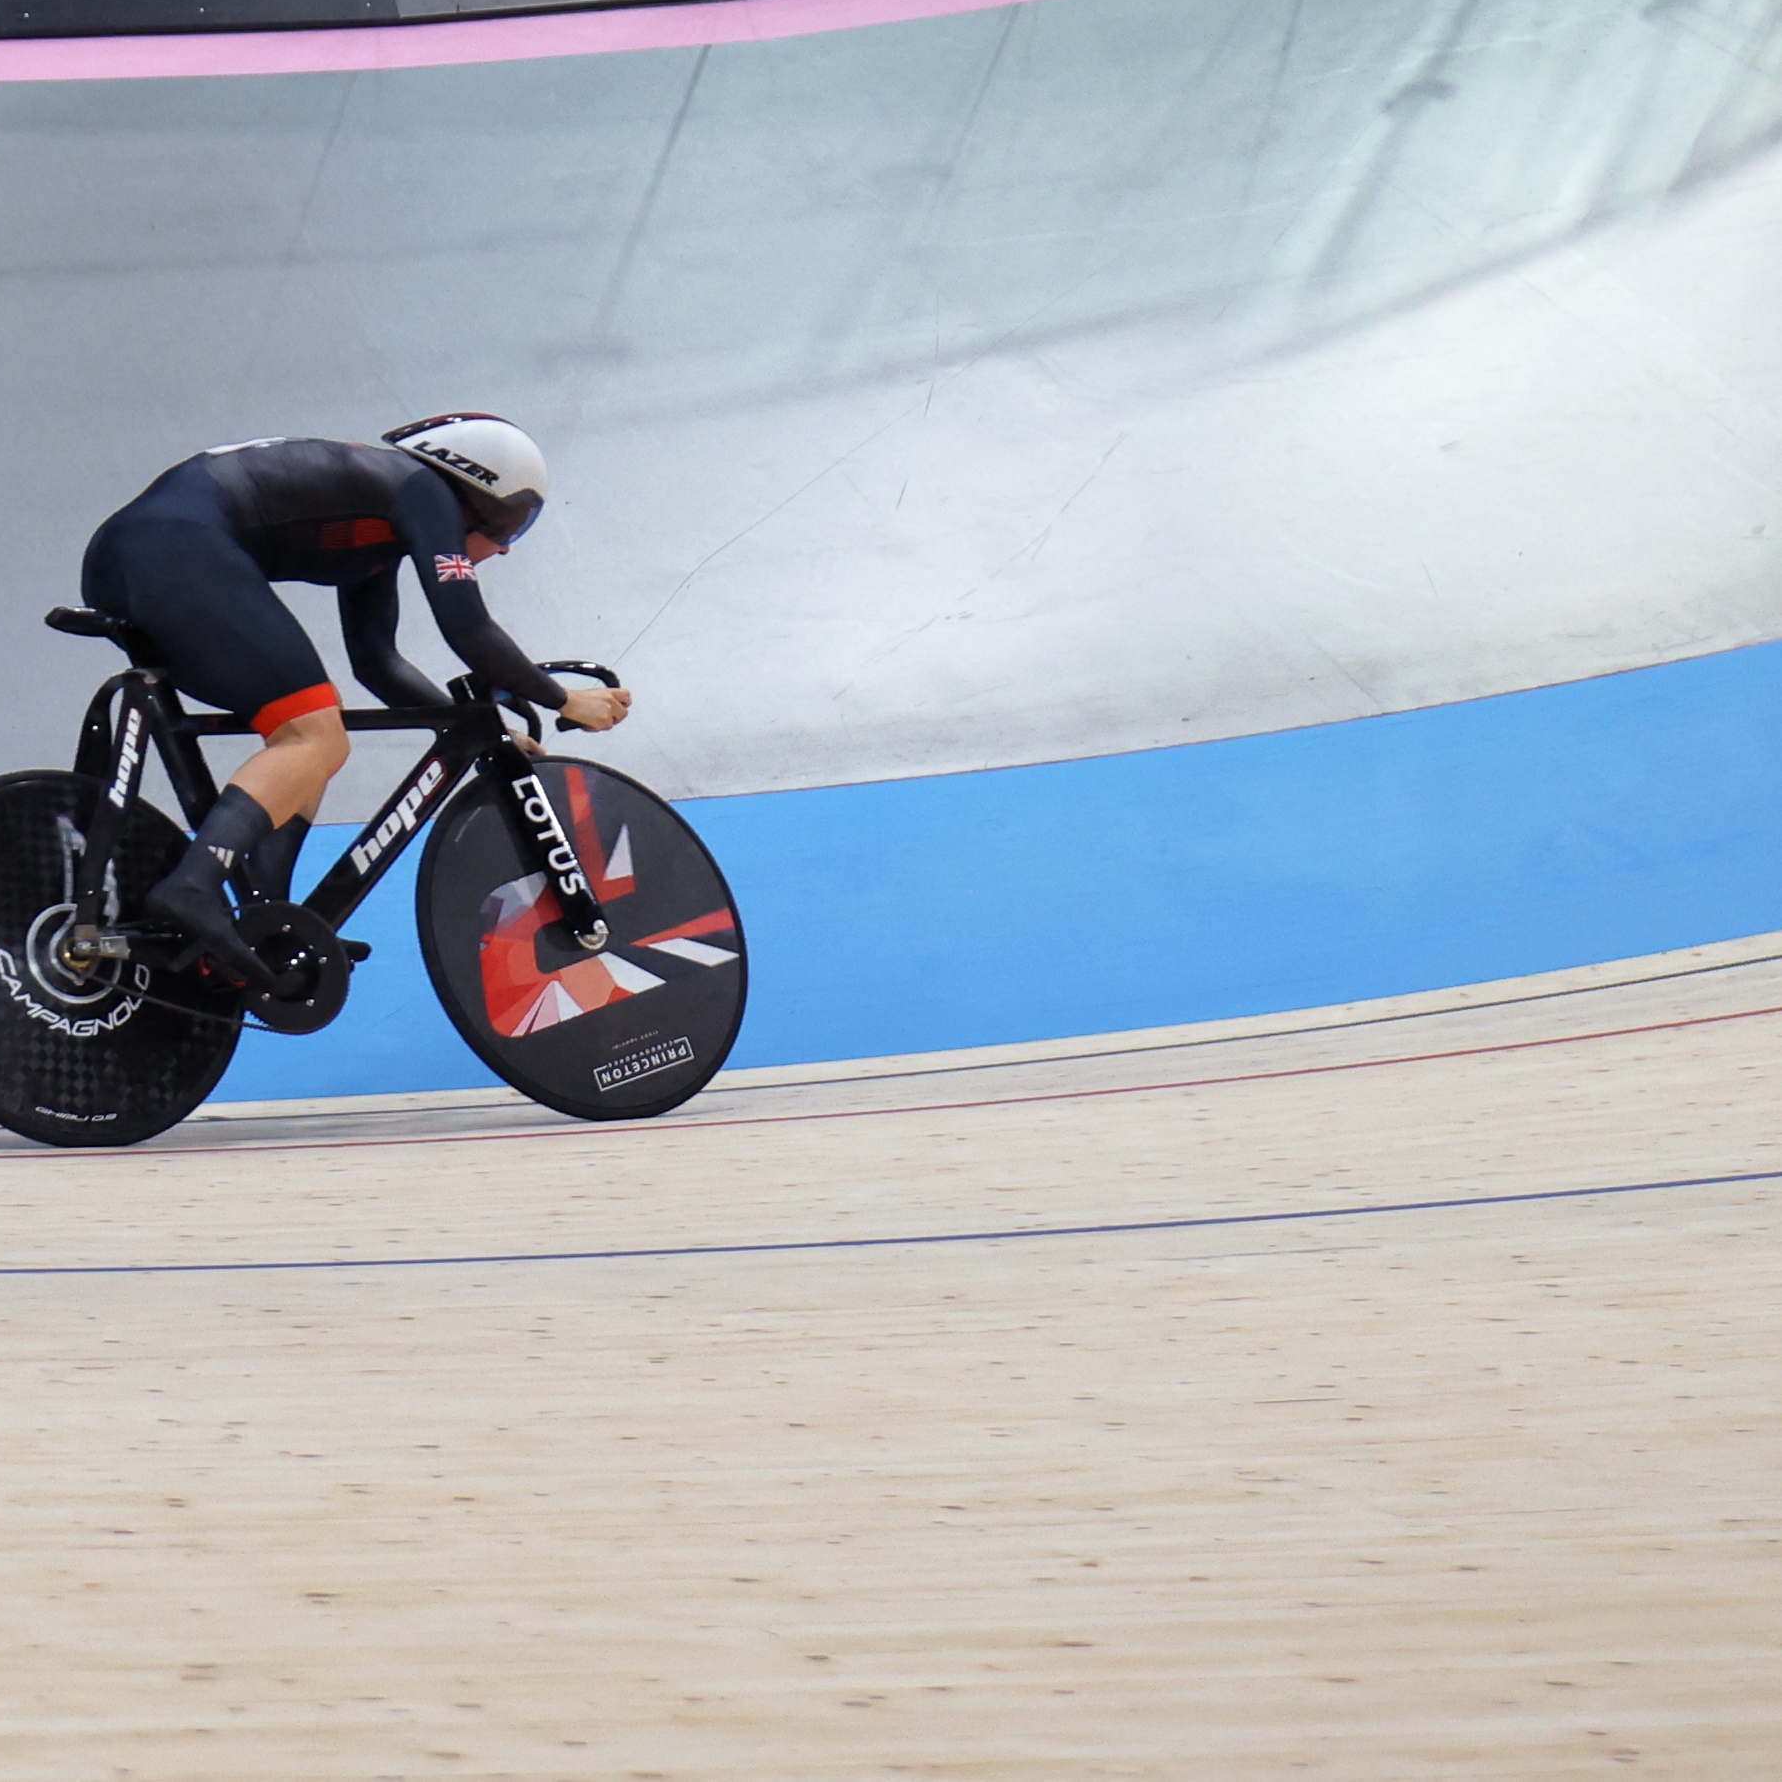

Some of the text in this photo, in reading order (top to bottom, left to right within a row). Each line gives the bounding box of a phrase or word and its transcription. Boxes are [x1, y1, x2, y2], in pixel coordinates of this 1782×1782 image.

[413, 440, 500, 486] LAZER
[108, 707, 142, 809] hope
[350, 760, 444, 875] hope
[511, 773, 585, 896] LOTUS
[600, 1044, 688, 1084] PRINCETON
